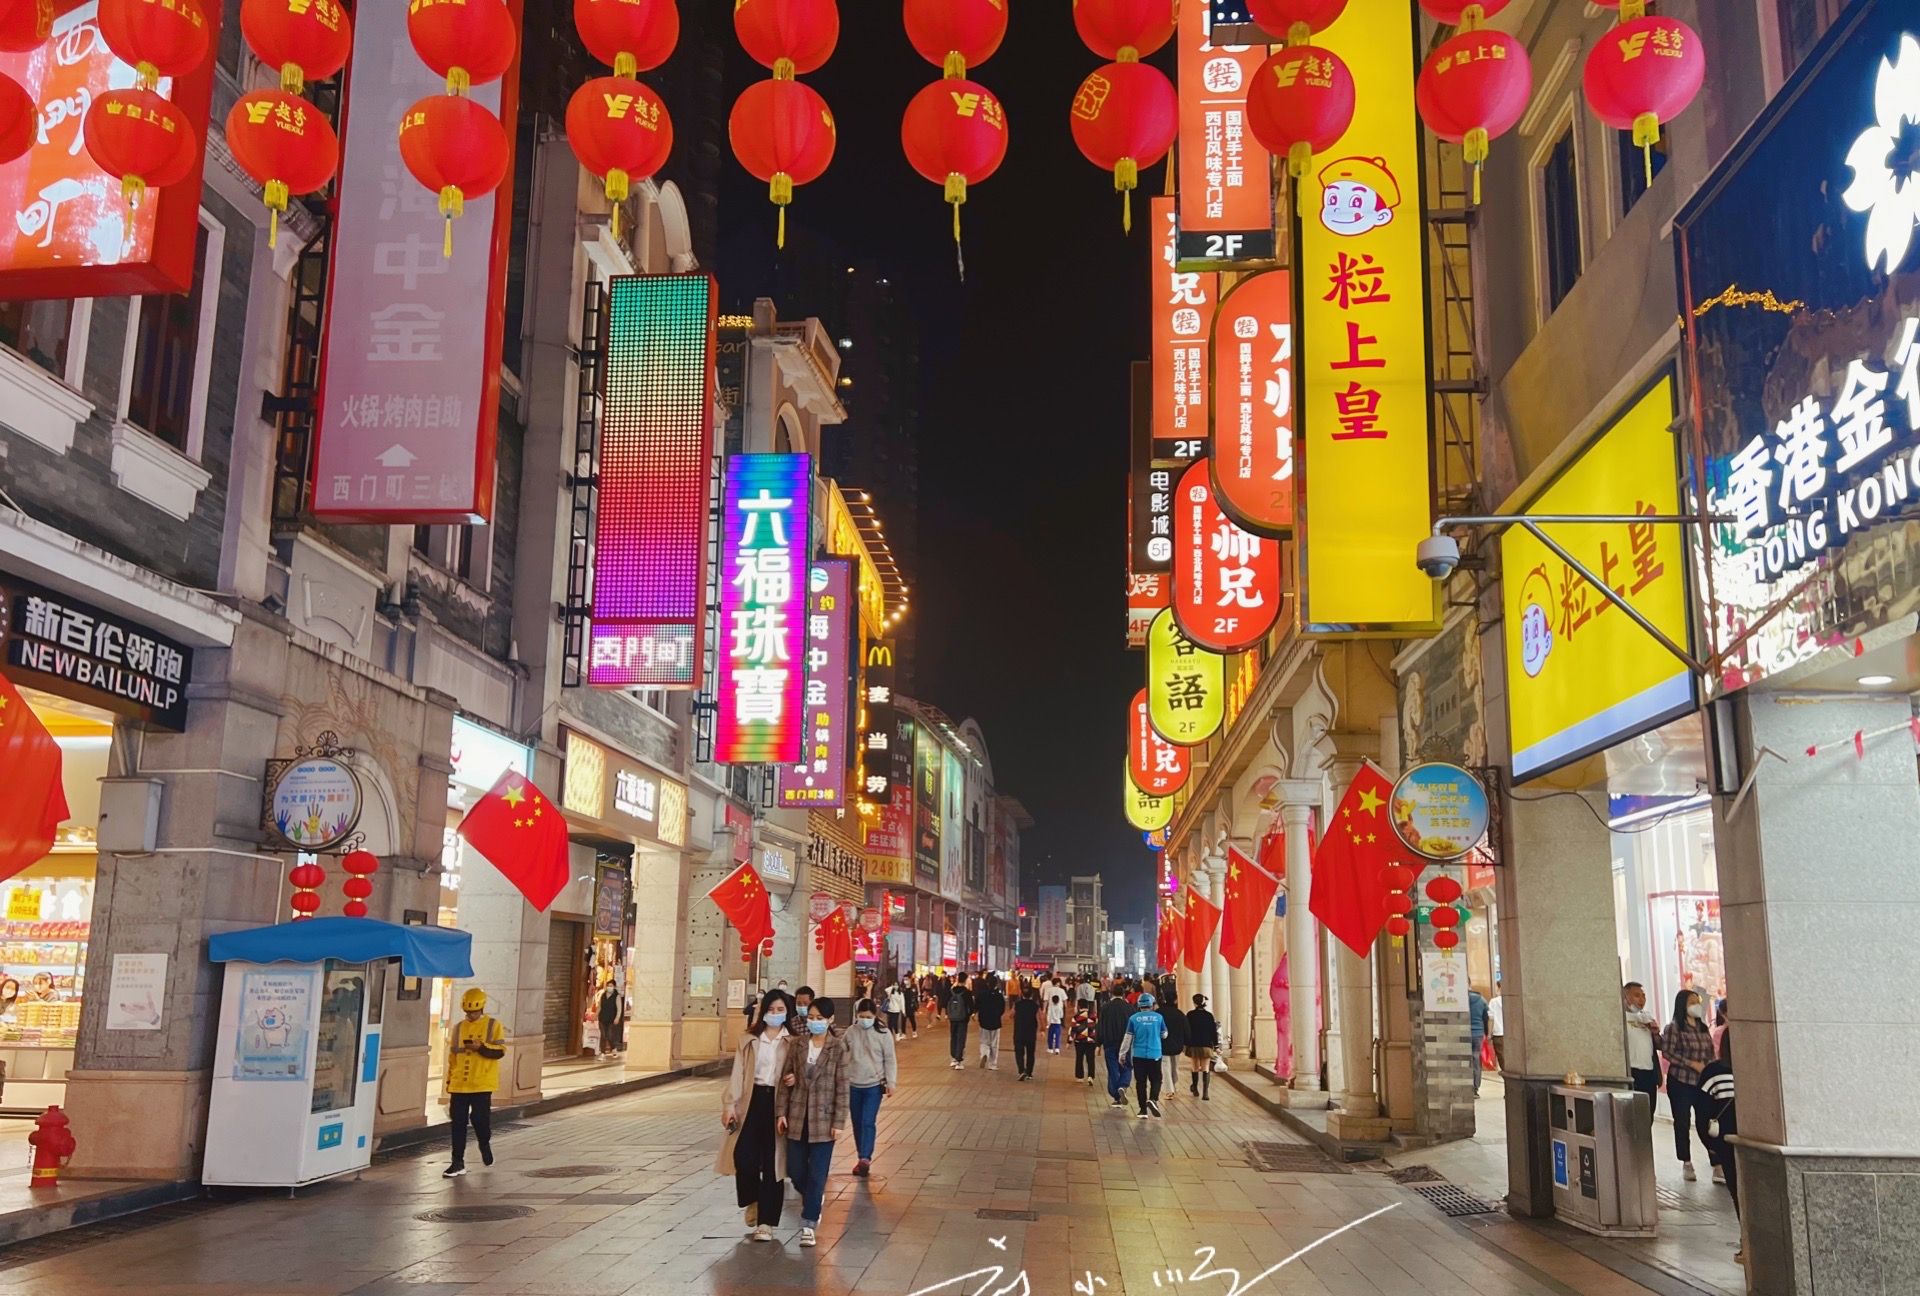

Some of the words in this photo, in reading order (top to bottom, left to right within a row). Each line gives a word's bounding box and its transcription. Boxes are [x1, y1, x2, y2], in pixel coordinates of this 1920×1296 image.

[1205, 111, 1223, 218] 西北风味专门店
[1225, 110, 1243, 187] 国粹手工面
[1205, 235, 1243, 257] 2F
[1188, 348, 1201, 405] 国粹手工面
[1323, 252, 1391, 441] 粒上皇
[1174, 348, 1187, 428] 西北风味专门店
[1174, 440, 1202, 457] 2F
[1150, 470, 1170, 536] 电影城
[1151, 541, 1170, 558] 5F
[1558, 500, 1665, 642] 粒上皇
[1752, 510, 1827, 581] HONG
[24, 596, 184, 685] 新百伦领跑
[730, 489, 793, 726] 六福珠寶
[1213, 618, 1239, 634] 2F
[20, 639, 179, 711] NEWBAILUNLP
[866, 686, 890, 794] 麦当劳
[1179, 721, 1196, 733] 2F
[1153, 778, 1168, 787] 2F
[1144, 816, 1156, 824] 2F
